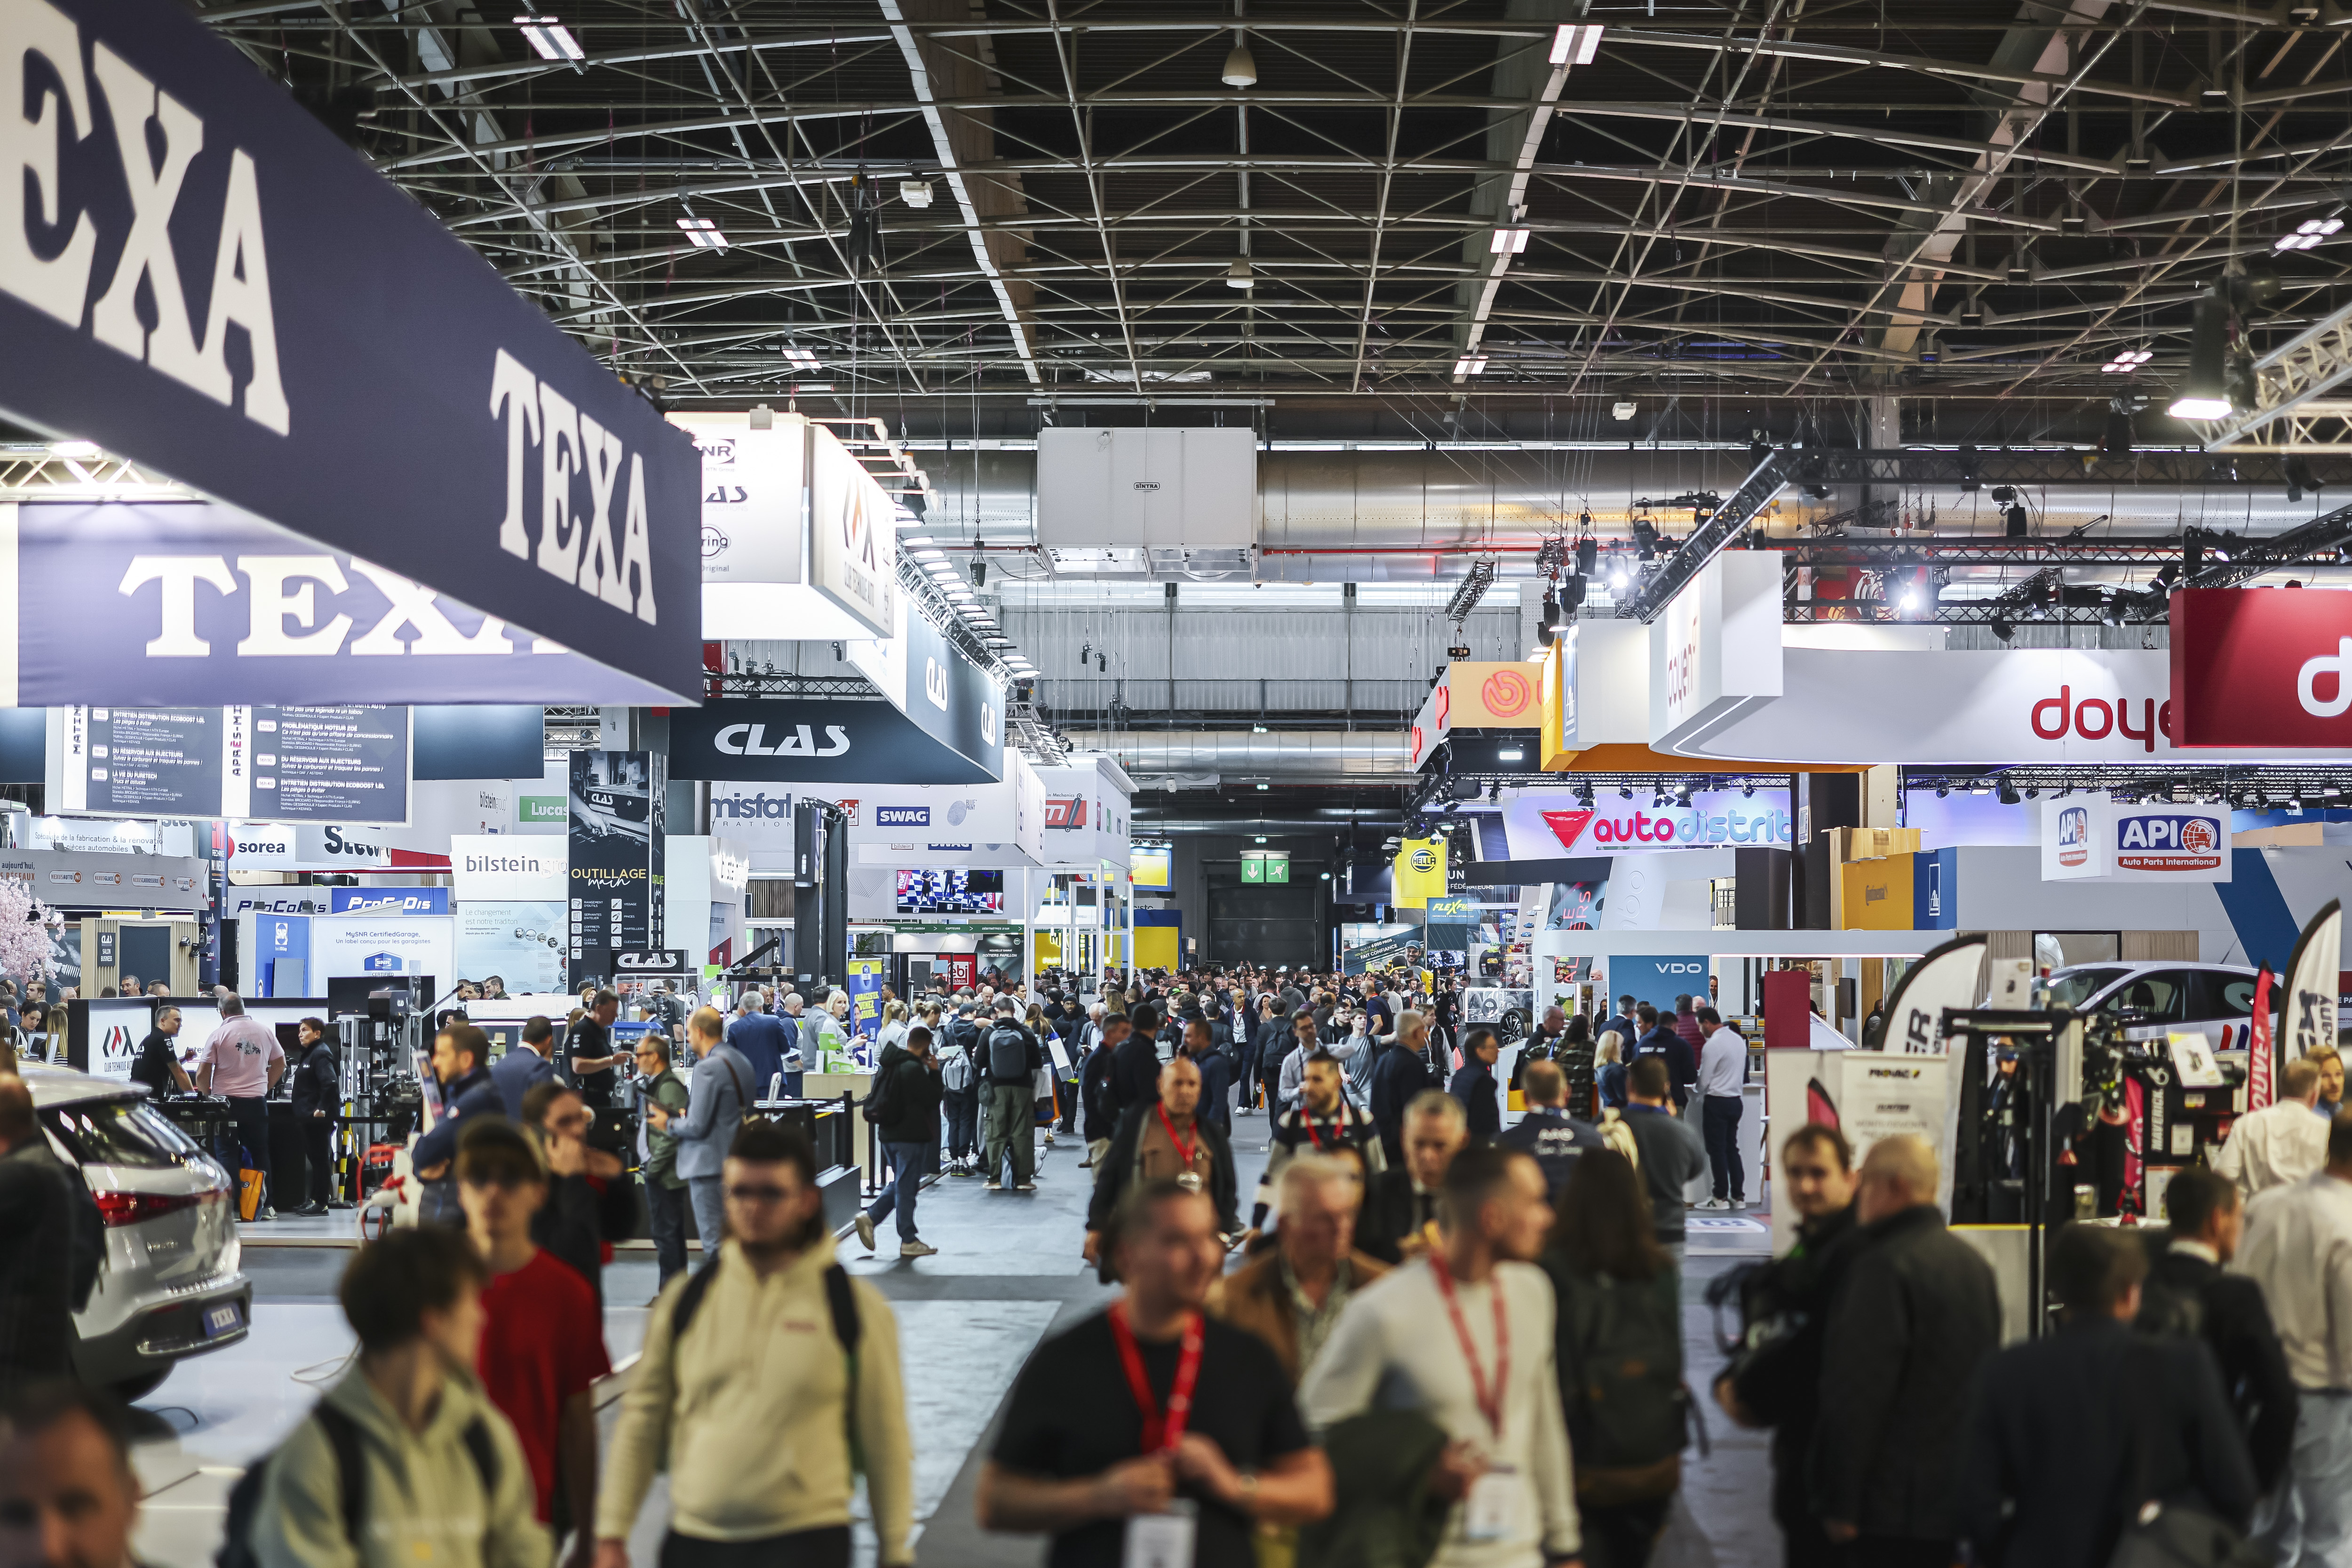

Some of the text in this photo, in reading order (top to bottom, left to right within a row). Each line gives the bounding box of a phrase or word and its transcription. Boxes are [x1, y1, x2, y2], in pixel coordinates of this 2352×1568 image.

[490, 347, 656, 626] TEXA
[119, 555, 568, 656] TEX
[230, 706, 242, 776] APRÈS-MI
[591, 794, 613, 805] CLAS
[2060, 812, 2075, 844] API
[2122, 820, 2178, 847] API
[76, 834, 110, 843] fabrication
[238, 843, 286, 853] sorea
[2, 861, 35, 870] aujourd'hui,
[1413, 857, 1436, 865] HELLA
[2143, 858, 2164, 866] Parts
[571, 868, 647, 879] OUTILLAGE
[588, 876, 631, 889] main
[1371, 943, 1398, 956] CONFIANCE
[1655, 963, 1702, 974] VDO
